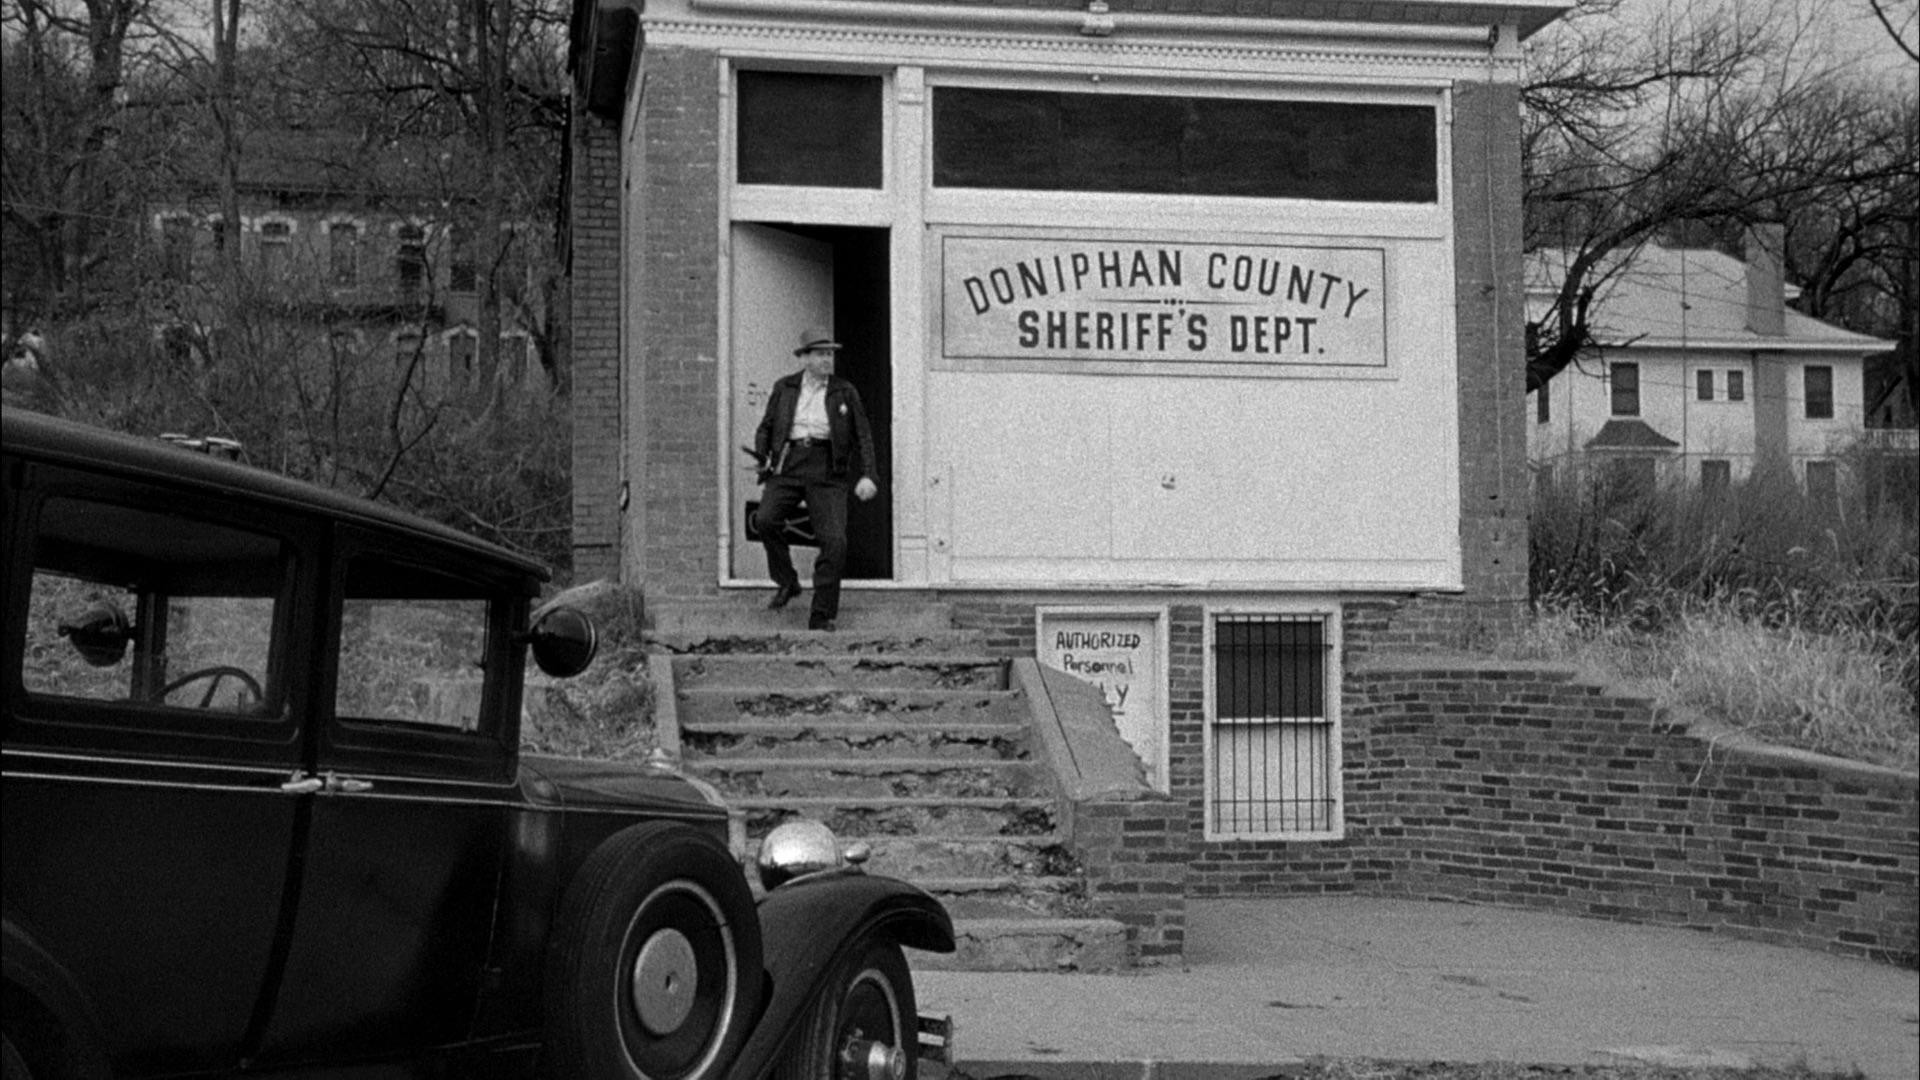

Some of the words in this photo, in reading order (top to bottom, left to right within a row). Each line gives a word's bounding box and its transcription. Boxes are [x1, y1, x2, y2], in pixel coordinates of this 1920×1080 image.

[964, 250, 1182, 315] DONIPHAN
[1207, 252, 1369, 318] COUNTY
[1018, 309, 1208, 351] SHERIFF'S
[1230, 315, 1325, 354] DEPT.
[1056, 631, 1141, 650] AUTHORIZED
[1063, 654, 1134, 675] Personnel
